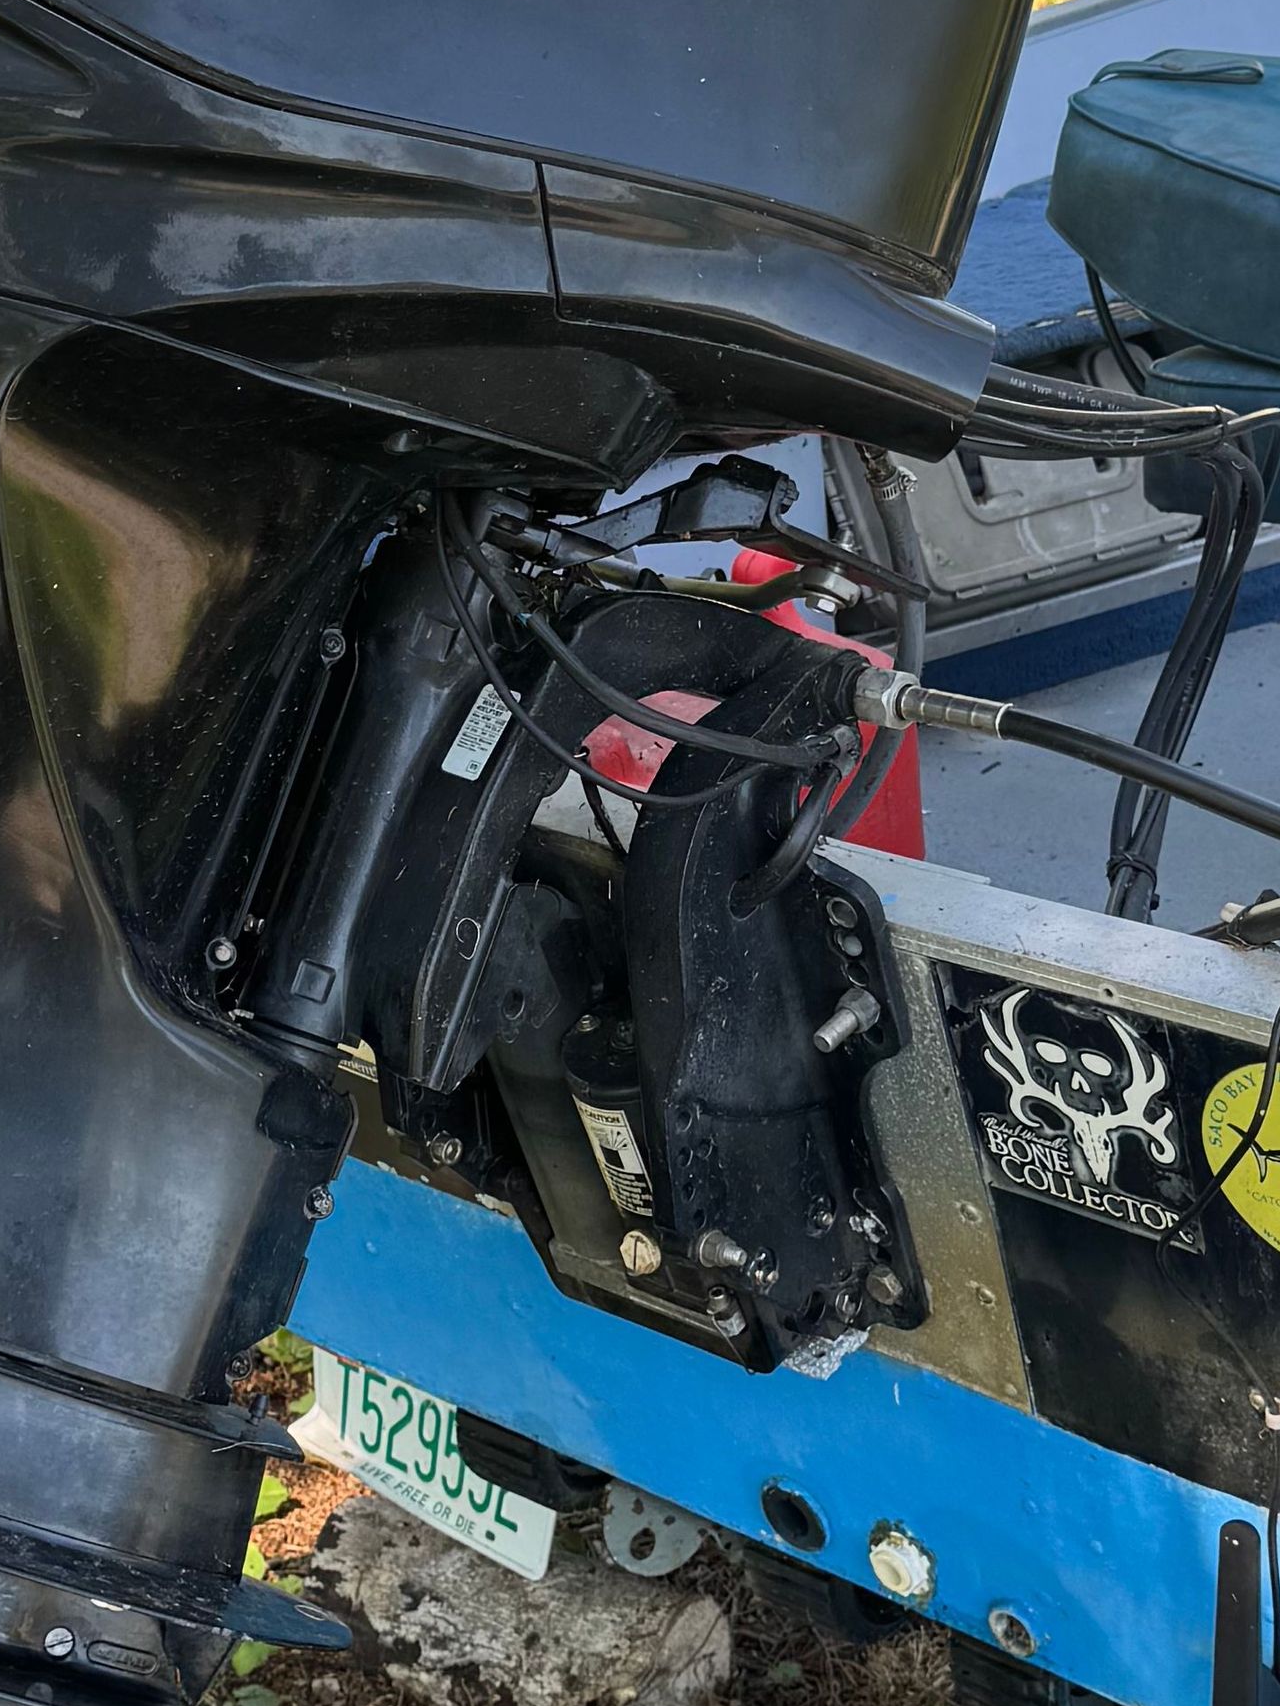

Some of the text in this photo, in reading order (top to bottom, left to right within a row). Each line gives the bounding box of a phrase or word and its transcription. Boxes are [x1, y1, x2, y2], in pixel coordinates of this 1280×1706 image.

[1209, 1098, 1229, 1148] SACO
[1223, 1071, 1257, 1100] BAY
[986, 1128, 1074, 1176] BONE
[359, 1461, 475, 1536] LIVE FREE OR DIE
